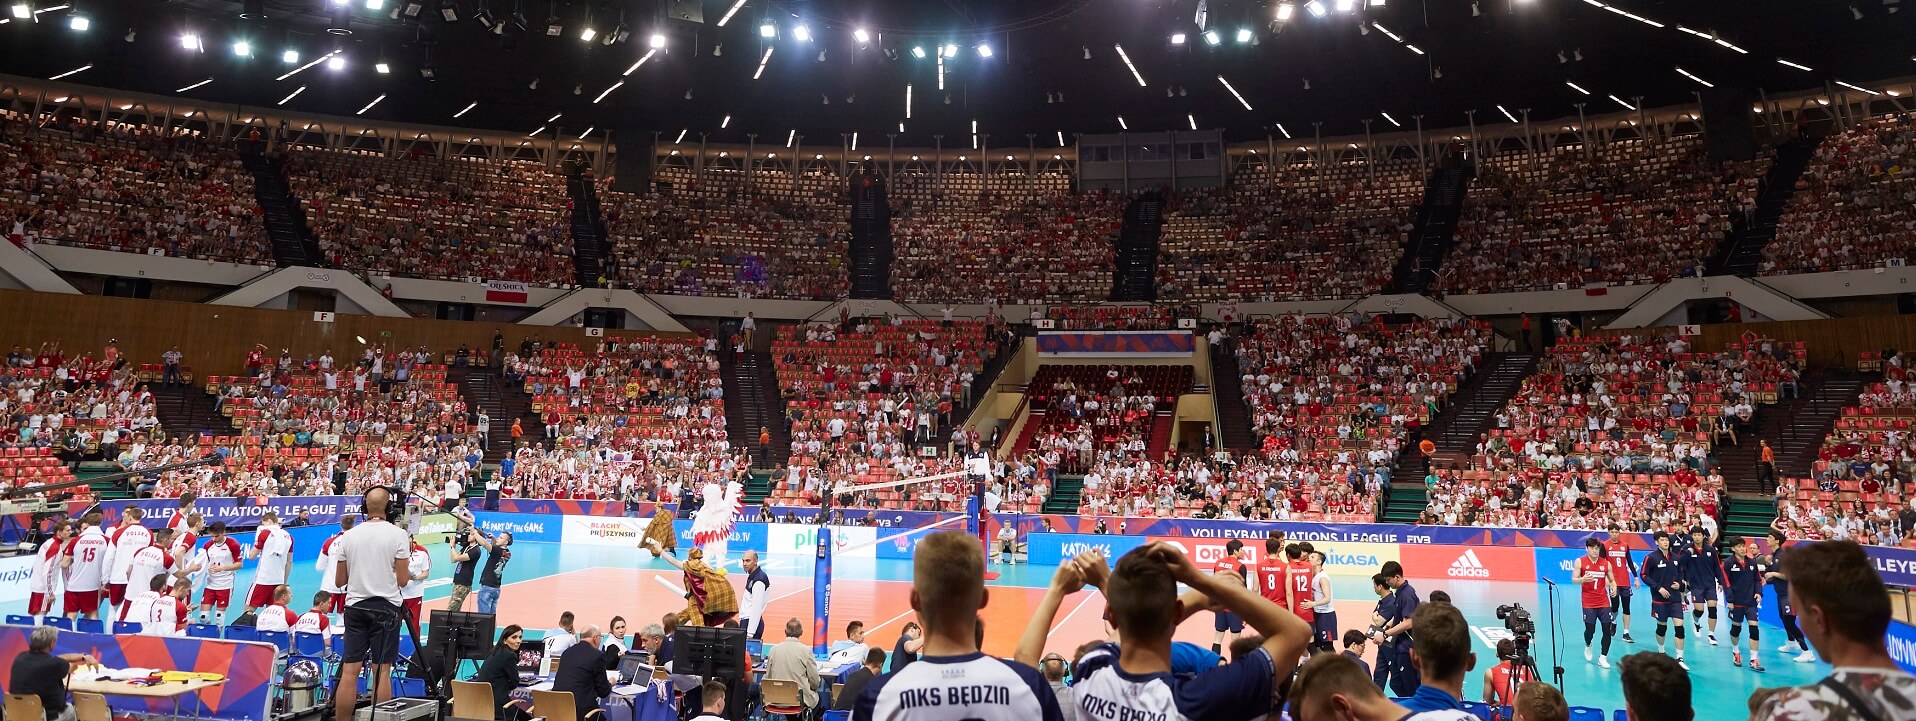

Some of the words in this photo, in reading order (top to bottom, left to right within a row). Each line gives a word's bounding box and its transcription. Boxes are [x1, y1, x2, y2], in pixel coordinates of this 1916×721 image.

[1891, 259, 1900, 267] M
[320, 313, 328, 321] F
[1042, 319, 1050, 328] H
[1184, 319, 1191, 328] J
[591, 328, 599, 336] G
[1684, 326, 1694, 334] K
[926, 447, 933, 455] H
[1220, 452, 1225, 460] J
[1539, 459, 1547, 468] K
[219, 504, 280, 517] NATIONS
[481, 520, 491, 530] BE
[490, 521, 505, 531] PART
[505, 521, 514, 530] OF
[513, 524, 524, 533] THE
[524, 522, 544, 534] GAME
[82, 547, 97, 563] 15
[1616, 556, 1622, 568] 6
[1447, 565, 1490, 578] adidas
[1267, 573, 1276, 590] 8
[1295, 575, 1308, 592] 12
[1593, 578, 1599, 590] 7
[156, 608, 163, 623] 3
[899, 686, 942, 710] MKS
[1082, 692, 1118, 720] MKS
